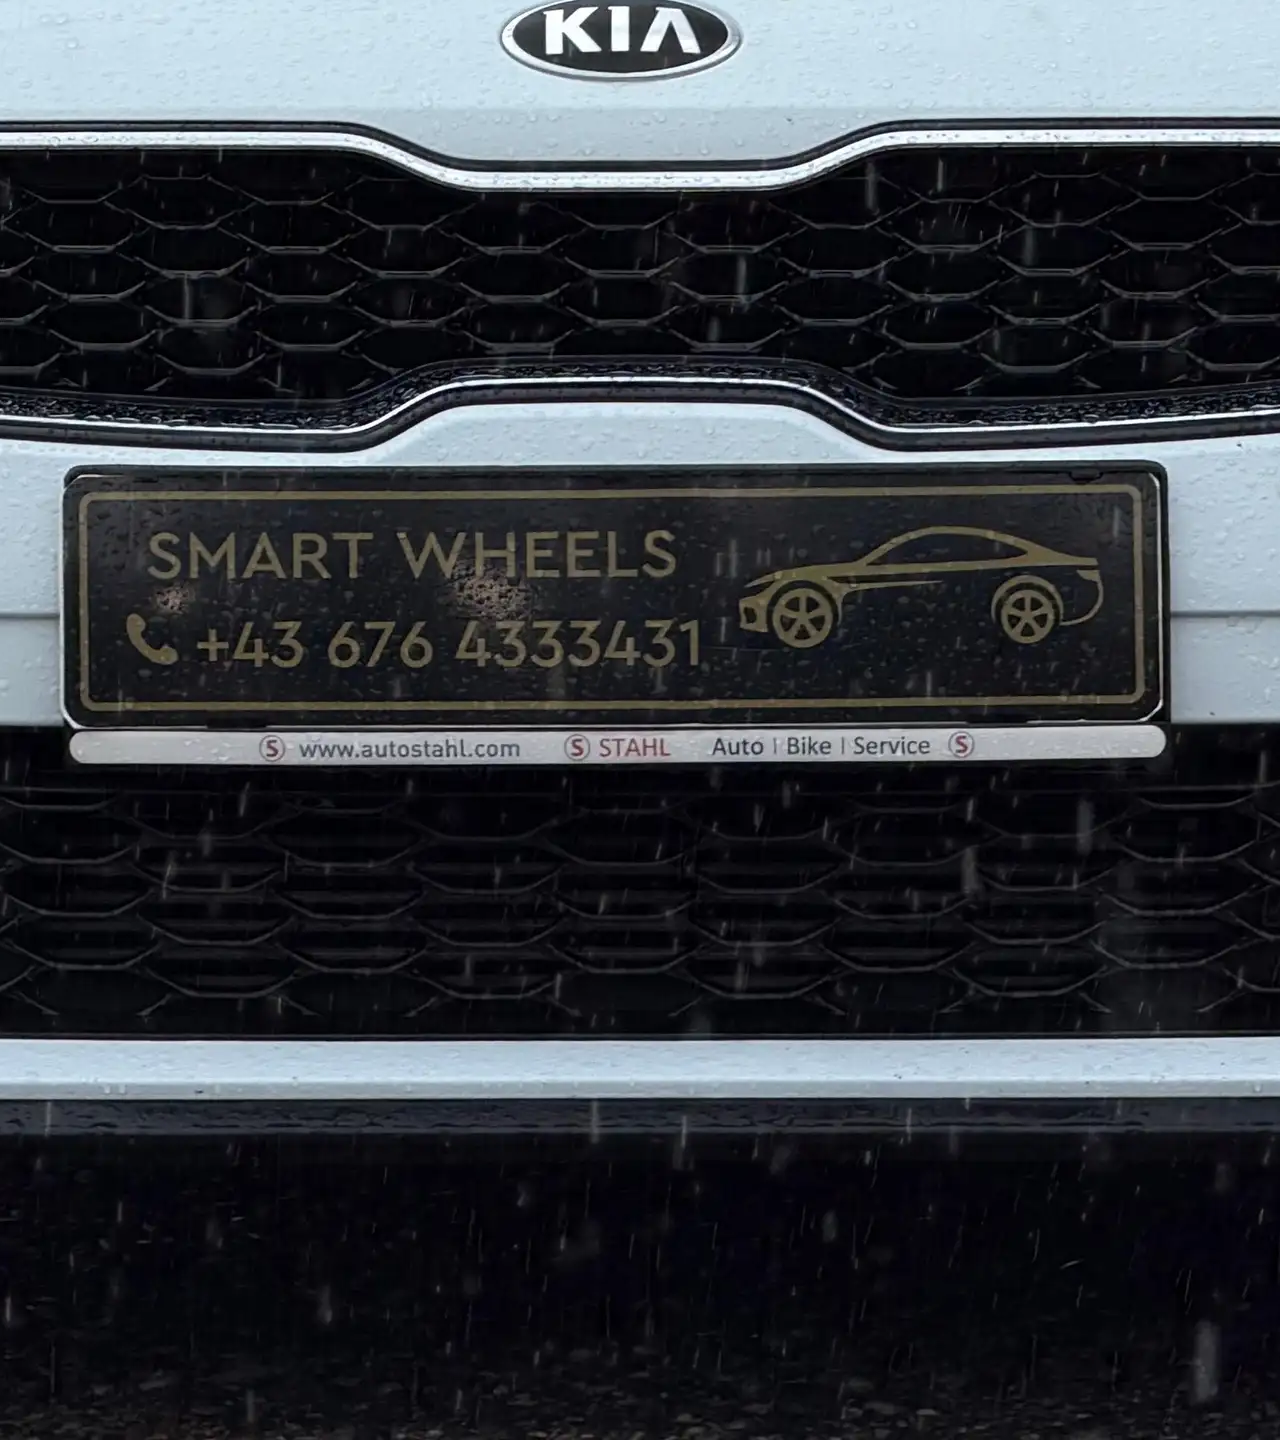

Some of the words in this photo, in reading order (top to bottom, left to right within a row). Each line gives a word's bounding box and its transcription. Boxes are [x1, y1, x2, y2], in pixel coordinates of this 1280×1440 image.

[543, 6, 701, 54] KIA
[147, 531, 374, 580] SMART
[396, 529, 677, 579] WHEELS
[196, 620, 304, 669] +43
[327, 620, 433, 669] 676
[455, 619, 700, 668] 4333431
[299, 738, 520, 760] www.autostahl.com
[599, 737, 671, 757] STAHL
[711, 737, 764, 756] Auto
[787, 736, 832, 755] Bike
[853, 736, 931, 755] Service
